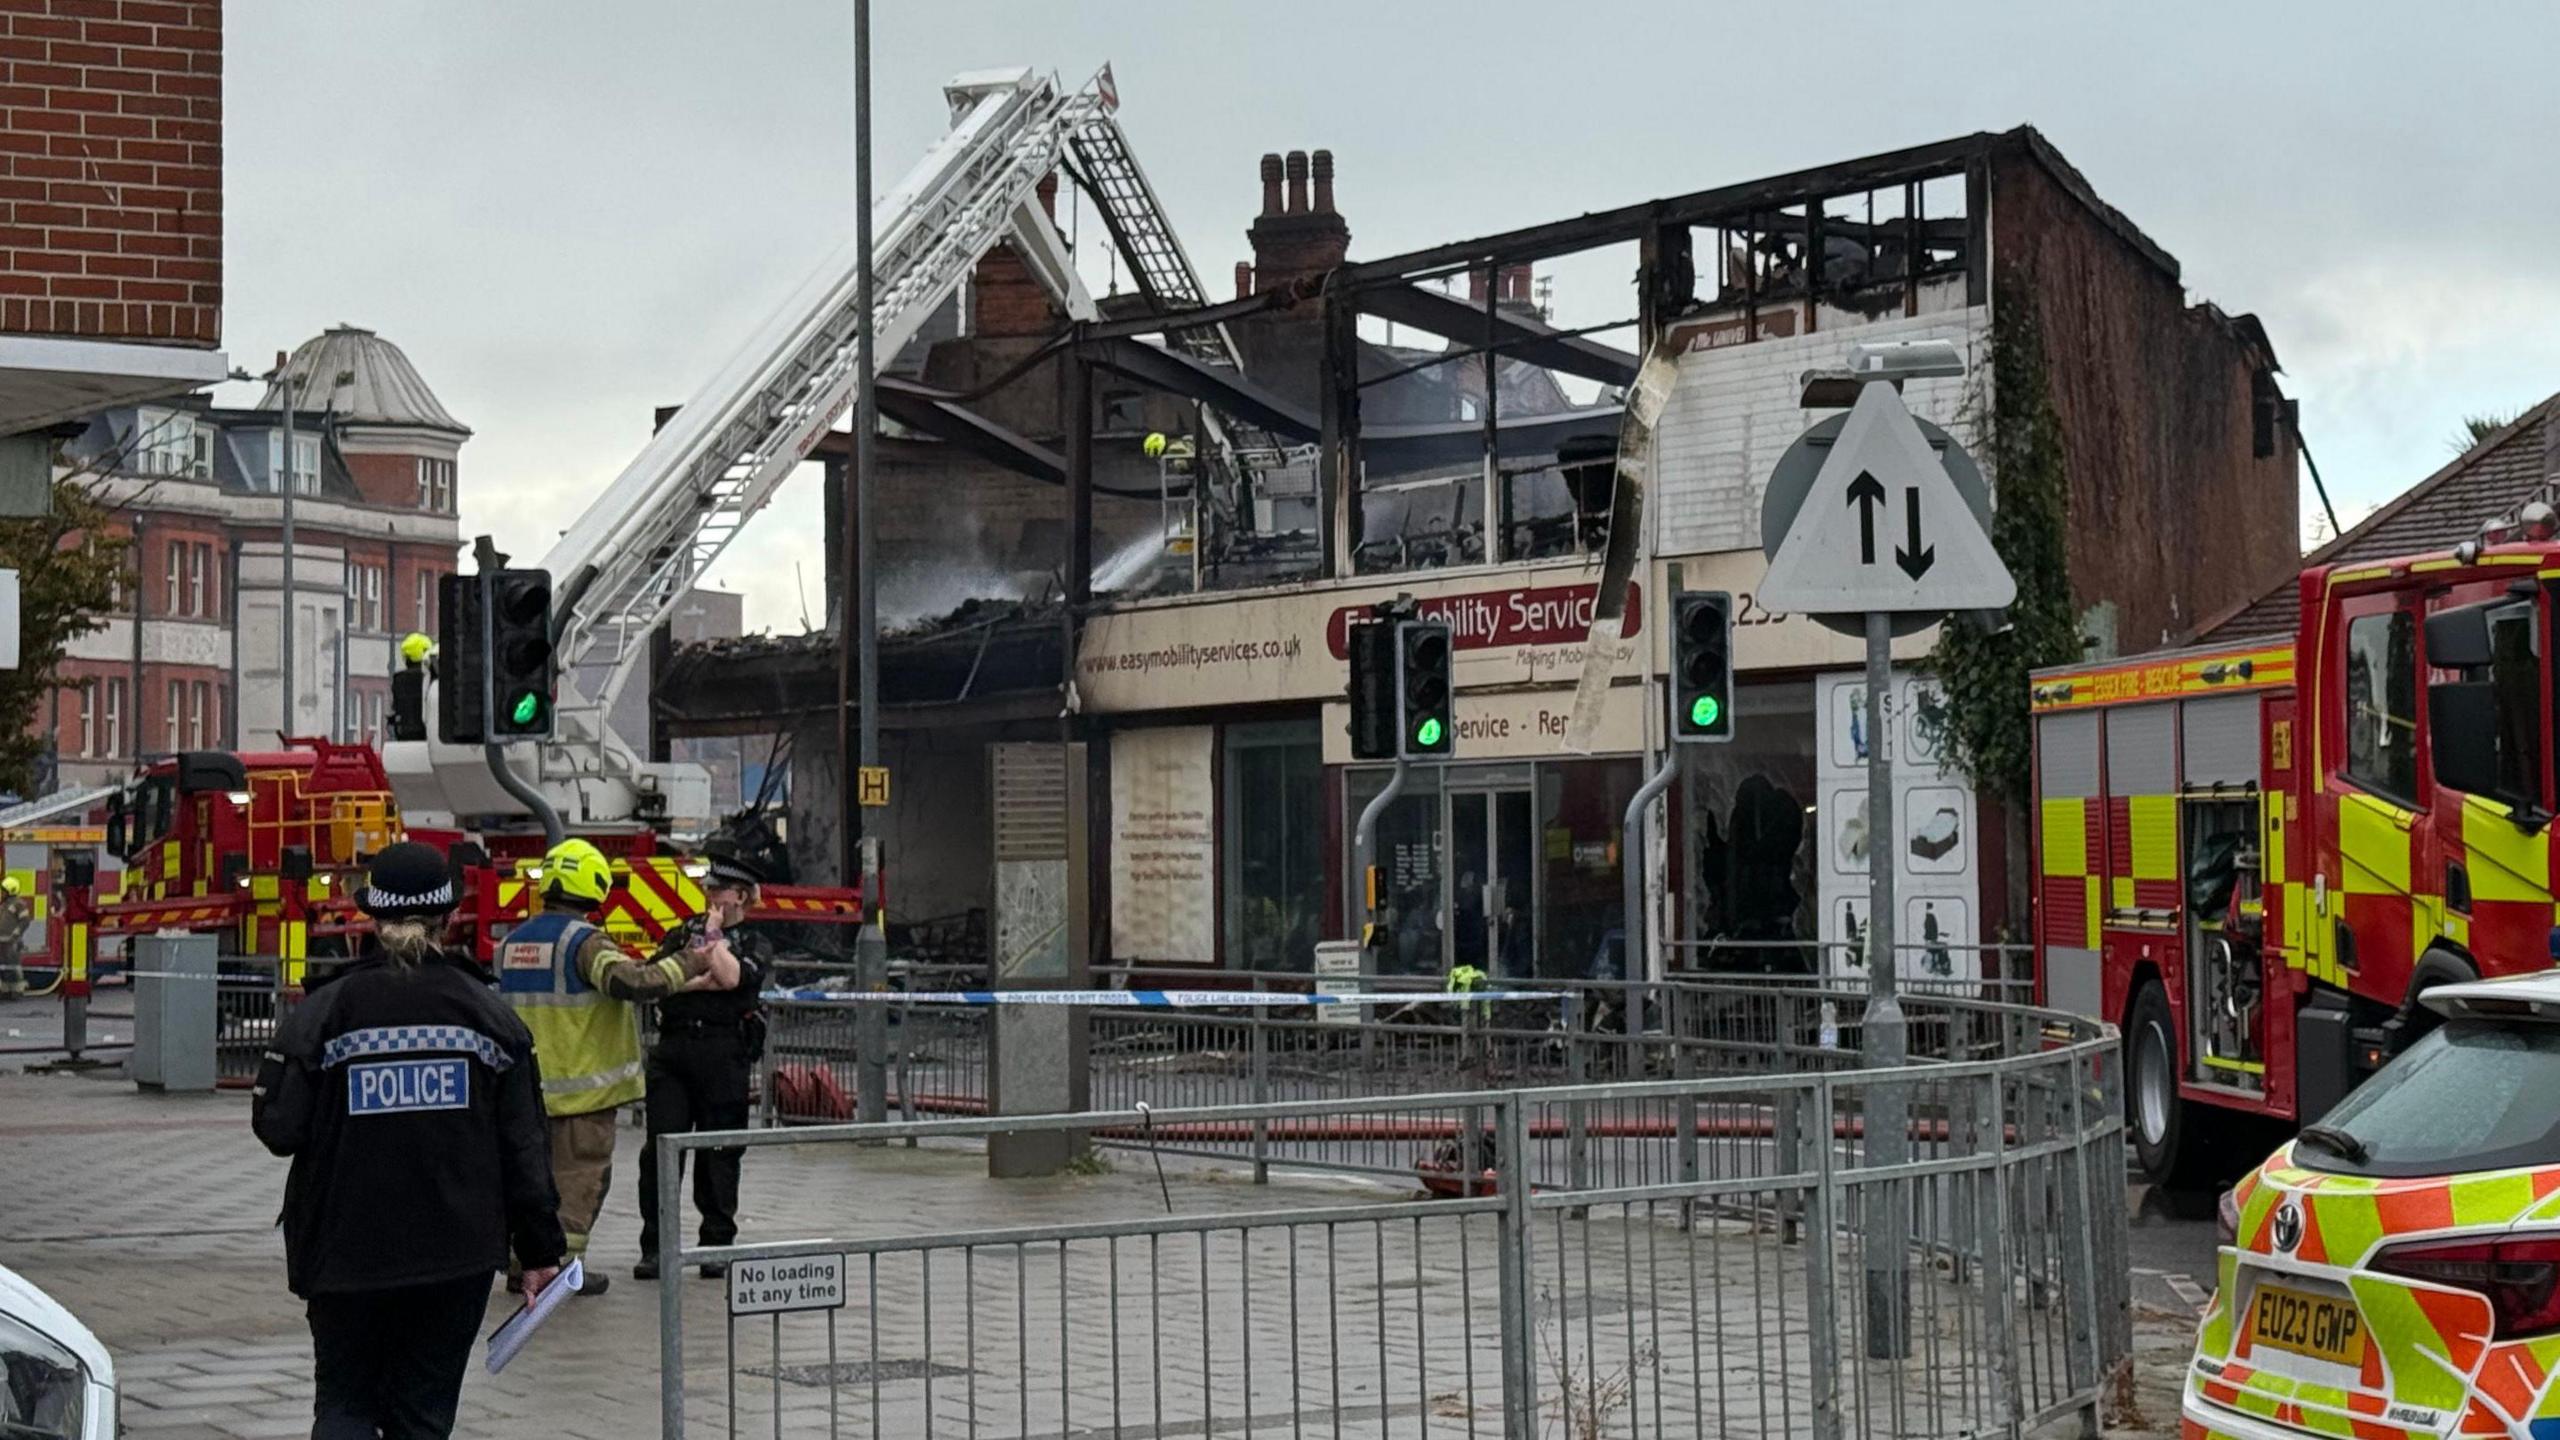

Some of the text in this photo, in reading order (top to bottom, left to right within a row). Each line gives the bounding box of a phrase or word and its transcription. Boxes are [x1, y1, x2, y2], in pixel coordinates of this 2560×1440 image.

[1085, 633, 1301, 675] www.easymobilityservices.co.uk
[864, 771, 885, 801] H
[360, 1065, 456, 1108] POLICE
[740, 1263, 835, 1284] No loading
[738, 1283, 837, 1304] at any time
[2258, 1292, 2357, 1354] EU23 GWP
